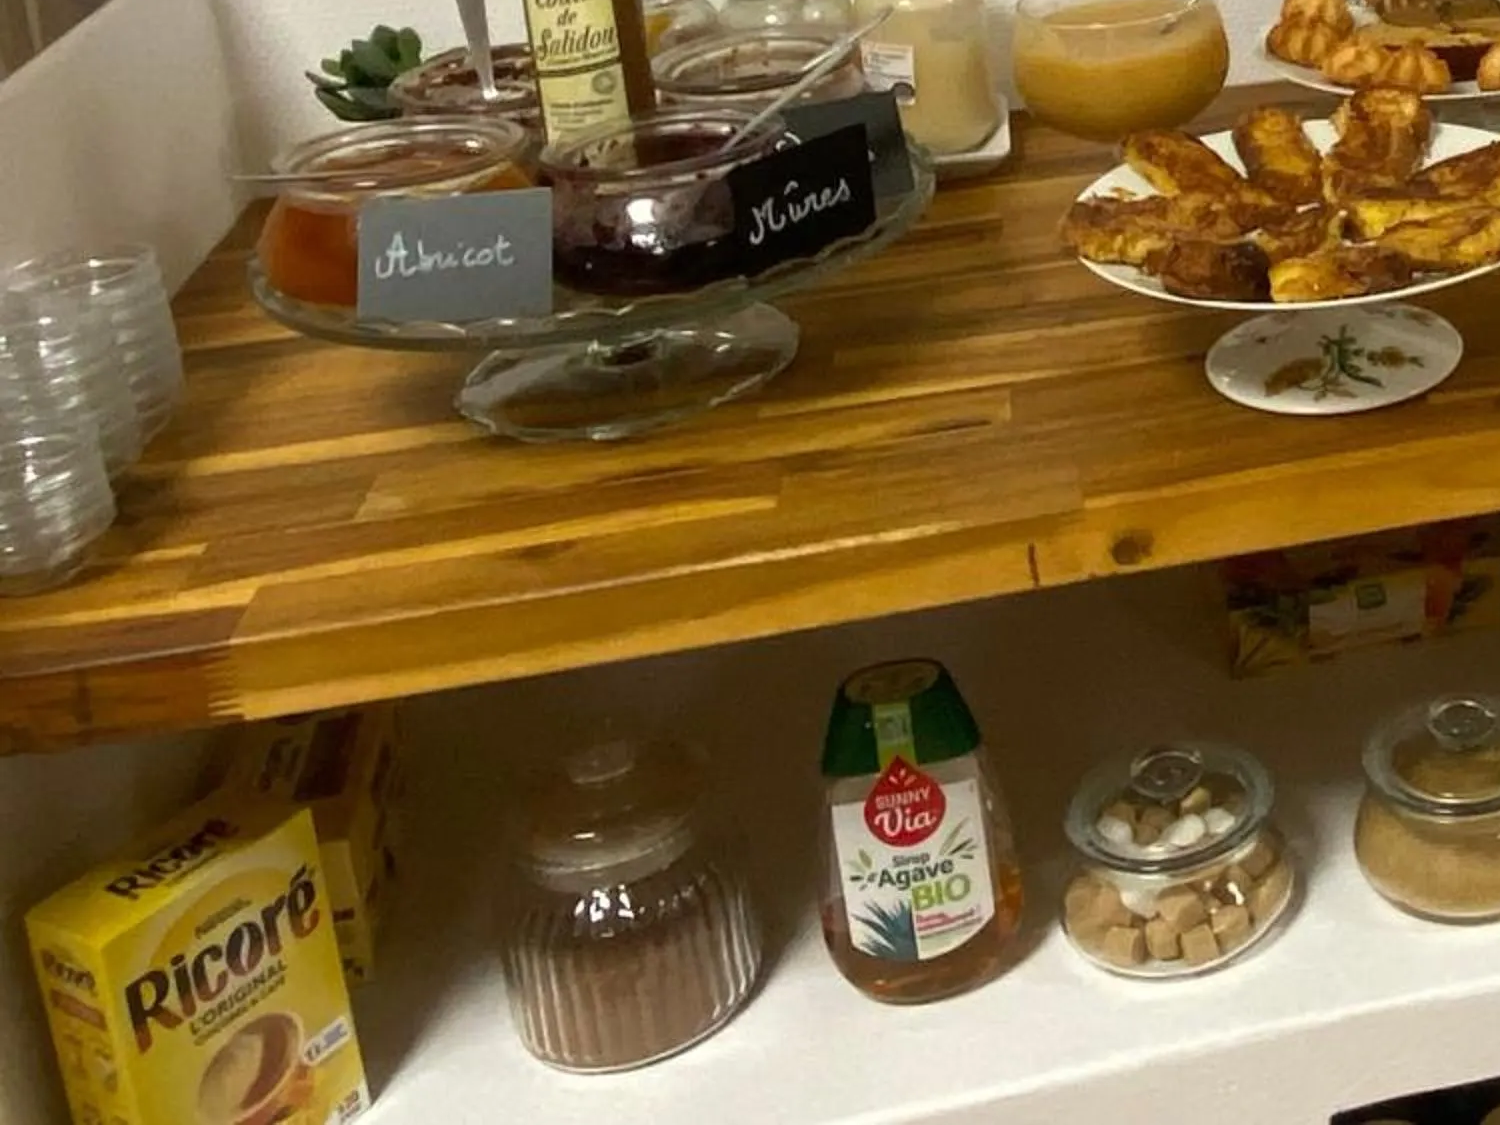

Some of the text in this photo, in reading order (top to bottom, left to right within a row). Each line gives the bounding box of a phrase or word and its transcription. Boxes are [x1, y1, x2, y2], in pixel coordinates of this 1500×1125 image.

[557, 9, 578, 27] de
[537, 25, 616, 61] Salidou
[749, 177, 851, 245] Mûres
[375, 231, 515, 279] Abricot
[875, 785, 931, 810] SUNNY
[874, 807, 937, 837] Via
[912, 873, 971, 911] BIO
[125, 865, 320, 1054] Ricoré
